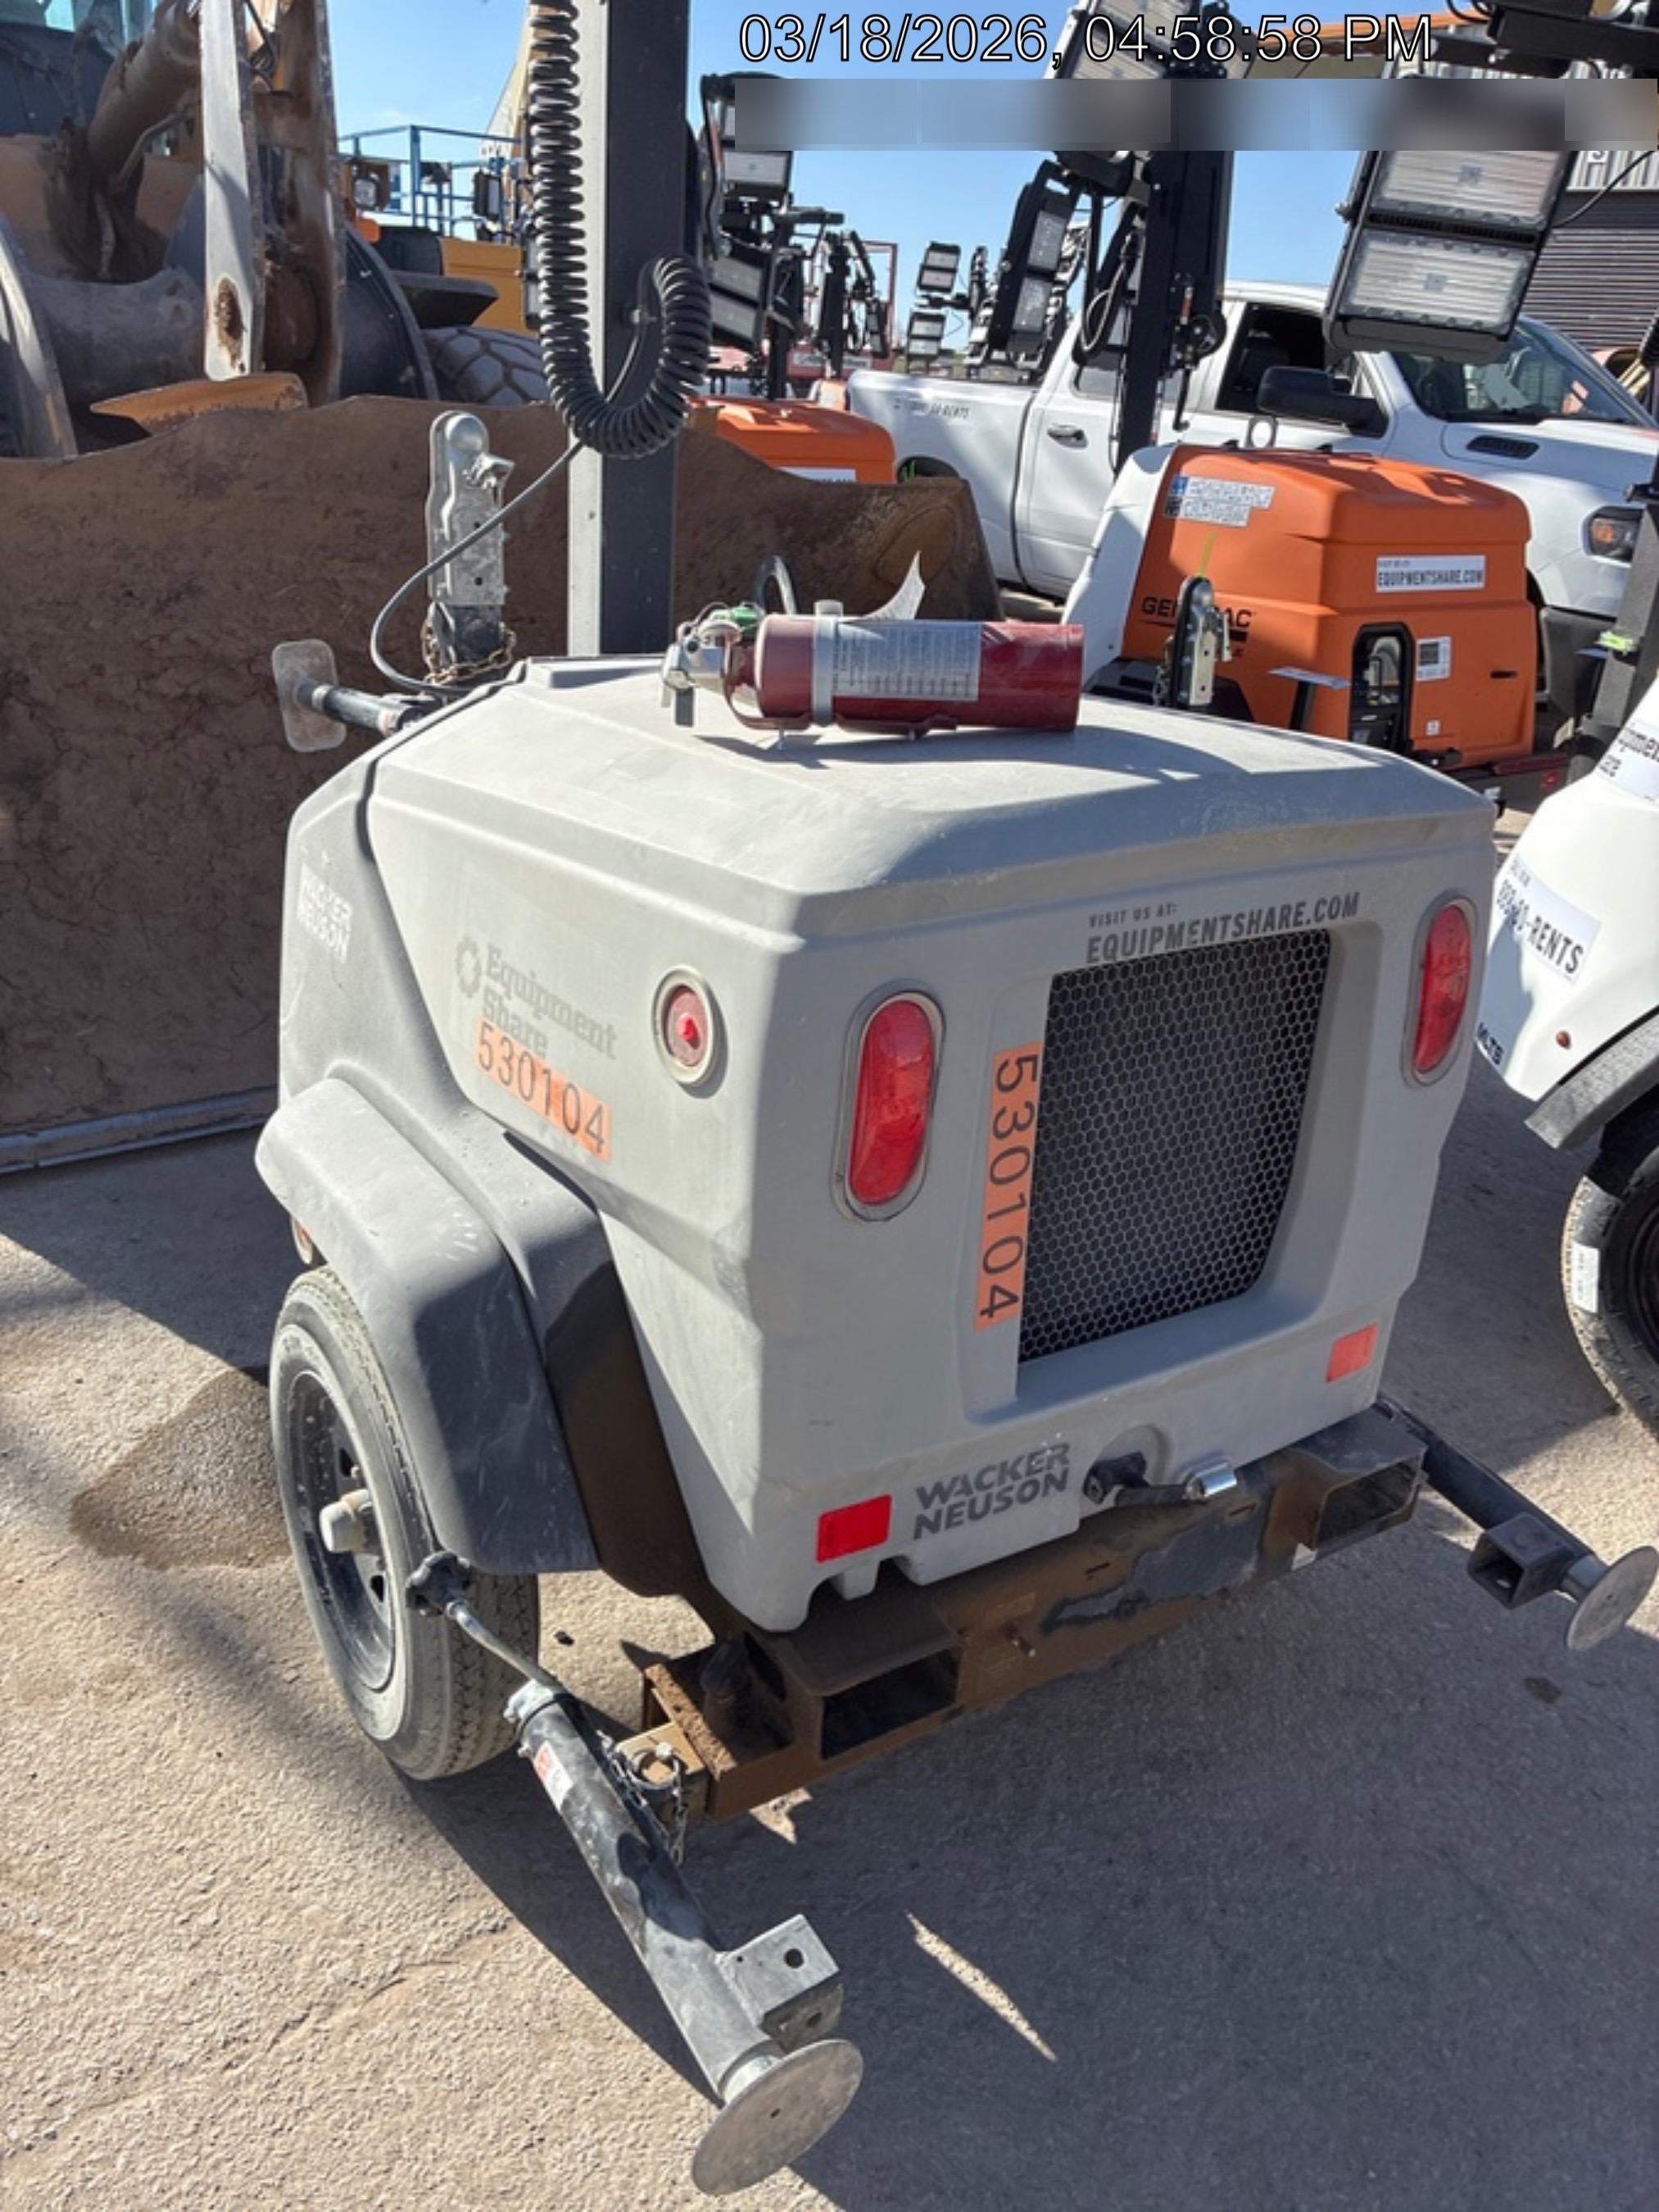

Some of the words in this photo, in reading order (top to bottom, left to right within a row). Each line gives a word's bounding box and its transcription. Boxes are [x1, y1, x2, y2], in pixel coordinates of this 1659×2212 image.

[1086, 891, 1361, 964] EQUIPMENTSHARE.COM
[1089, 910, 1126, 928] VISIT
[1133, 906, 1151, 922] US
[1156, 903, 1177, 918] AT:
[482, 985, 548, 1060] Share
[485, 943, 618, 1060] Equipment
[478, 1021, 605, 1154] 530104
[980, 1054, 1039, 1318] 530104
[913, 1467, 1069, 1540] NEUSON
[916, 1442, 1070, 1510] WACKER
